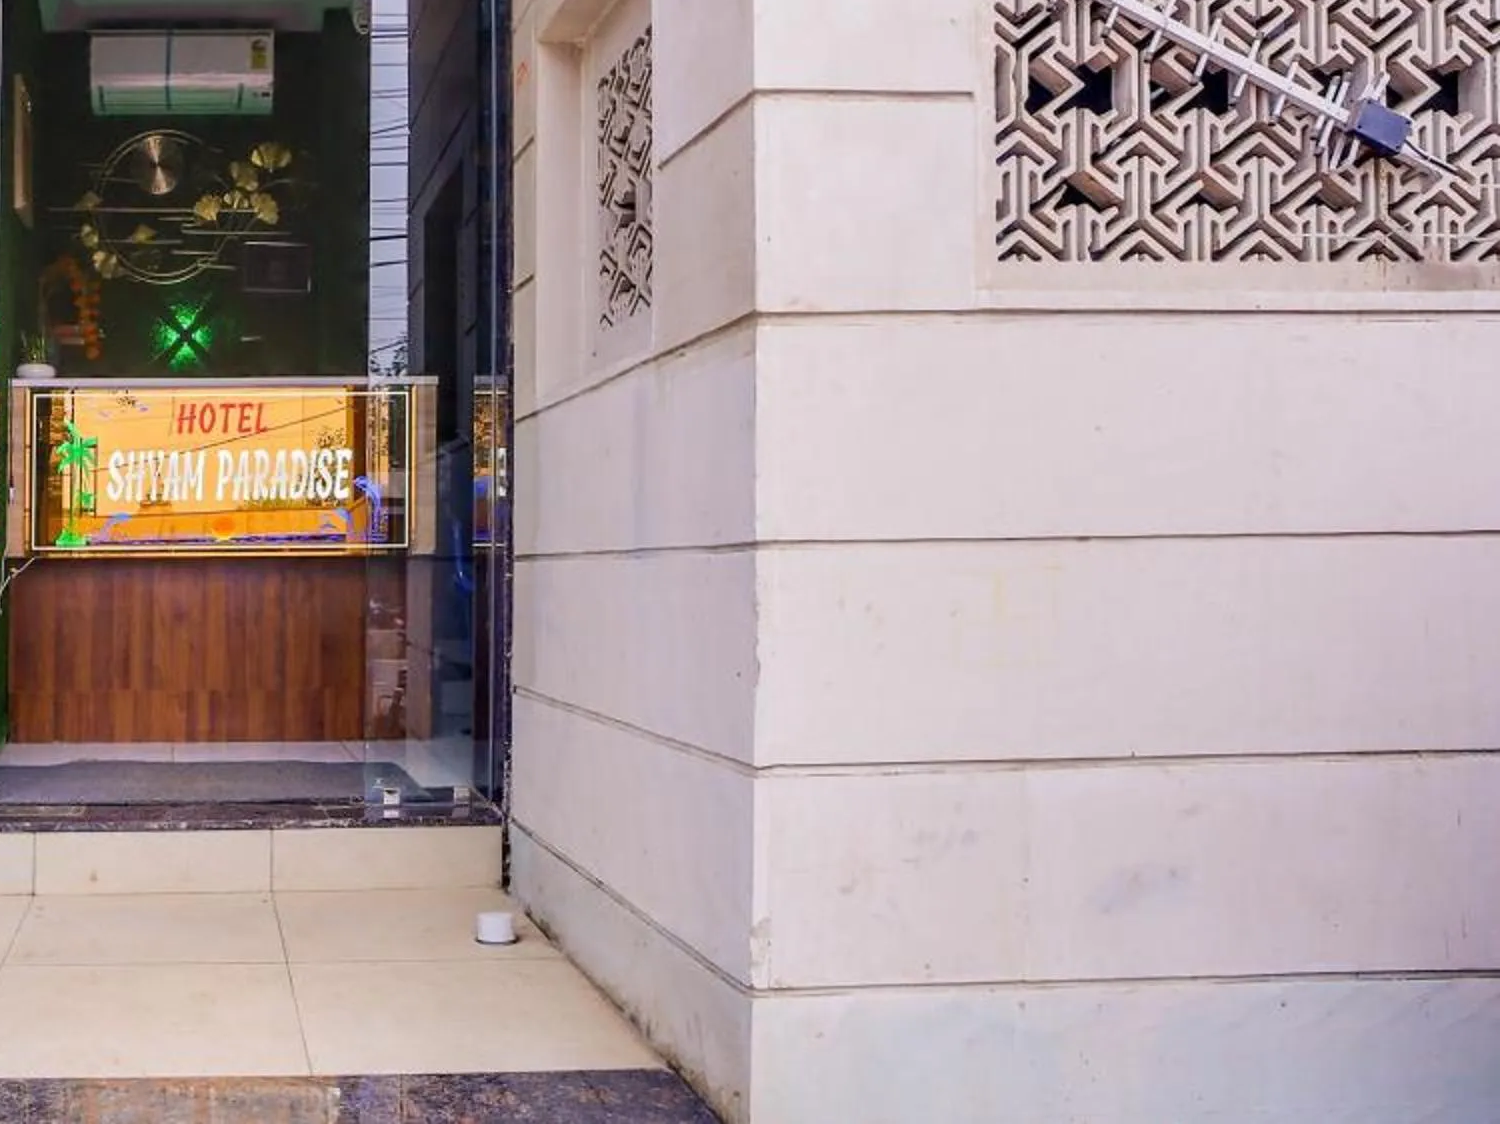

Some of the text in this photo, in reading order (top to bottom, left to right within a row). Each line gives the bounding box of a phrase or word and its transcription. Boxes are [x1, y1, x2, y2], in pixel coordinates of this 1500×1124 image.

[177, 402, 268, 435] HOTEL
[107, 447, 354, 503] SHYAM PARADISE
